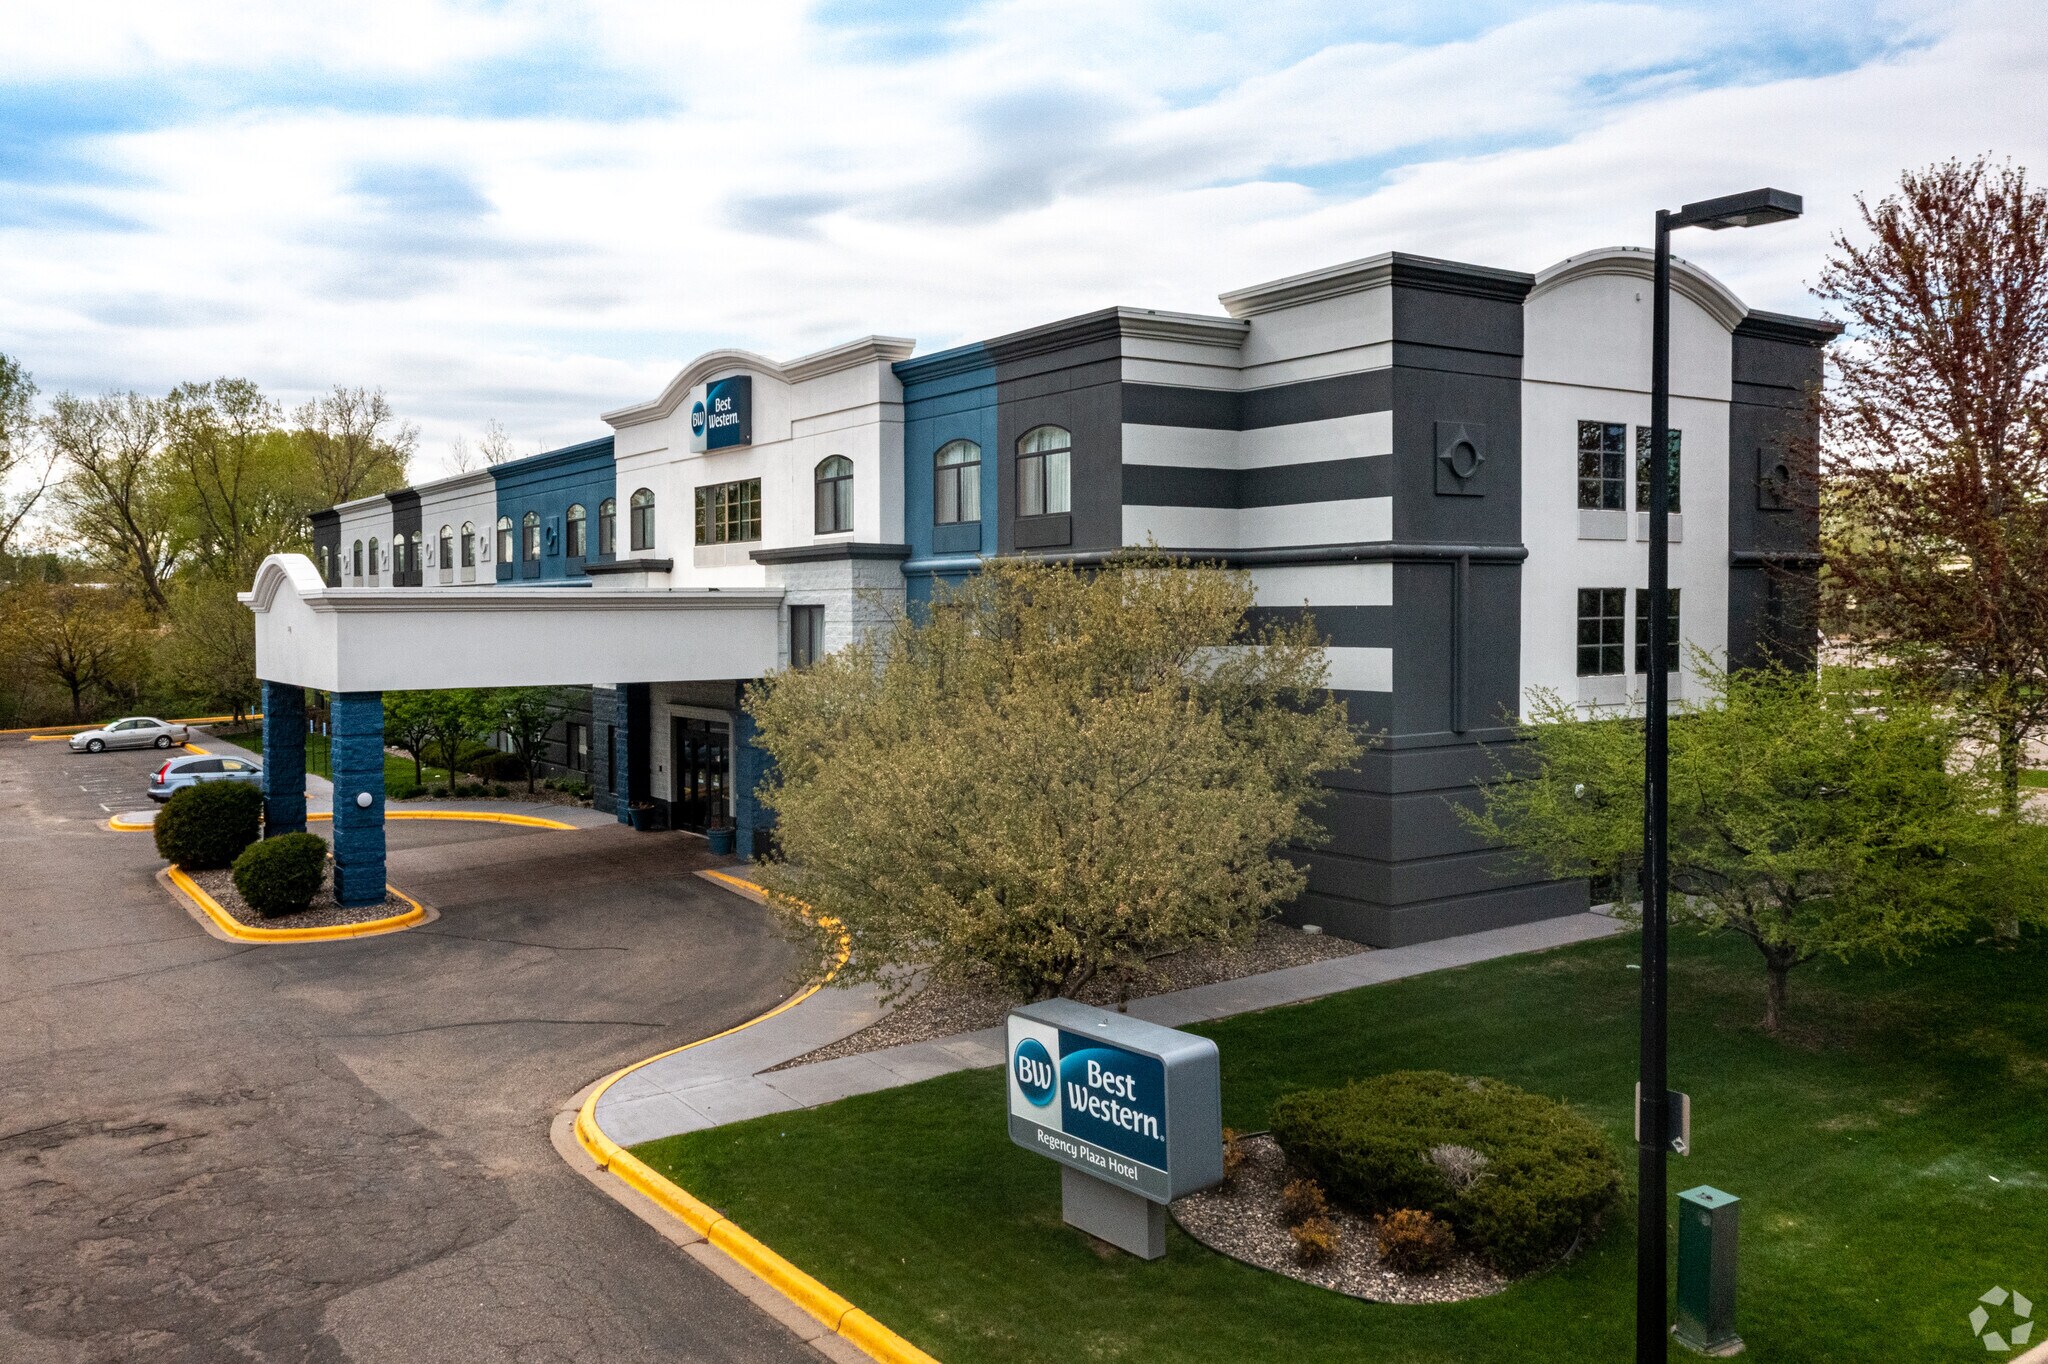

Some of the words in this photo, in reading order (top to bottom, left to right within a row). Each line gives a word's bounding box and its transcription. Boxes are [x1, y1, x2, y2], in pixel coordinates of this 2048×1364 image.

[692, 411, 704, 427] BW
[708, 412, 738, 429] Western
[715, 397, 731, 412] Best
[1018, 1055, 1051, 1090] BW
[1087, 1059, 1137, 1101] Best
[1067, 1081, 1160, 1141] Western
[1037, 1128, 1078, 1158] Regency
[1080, 1146, 1106, 1168] Plaza
[1109, 1156, 1138, 1181] Hotel
